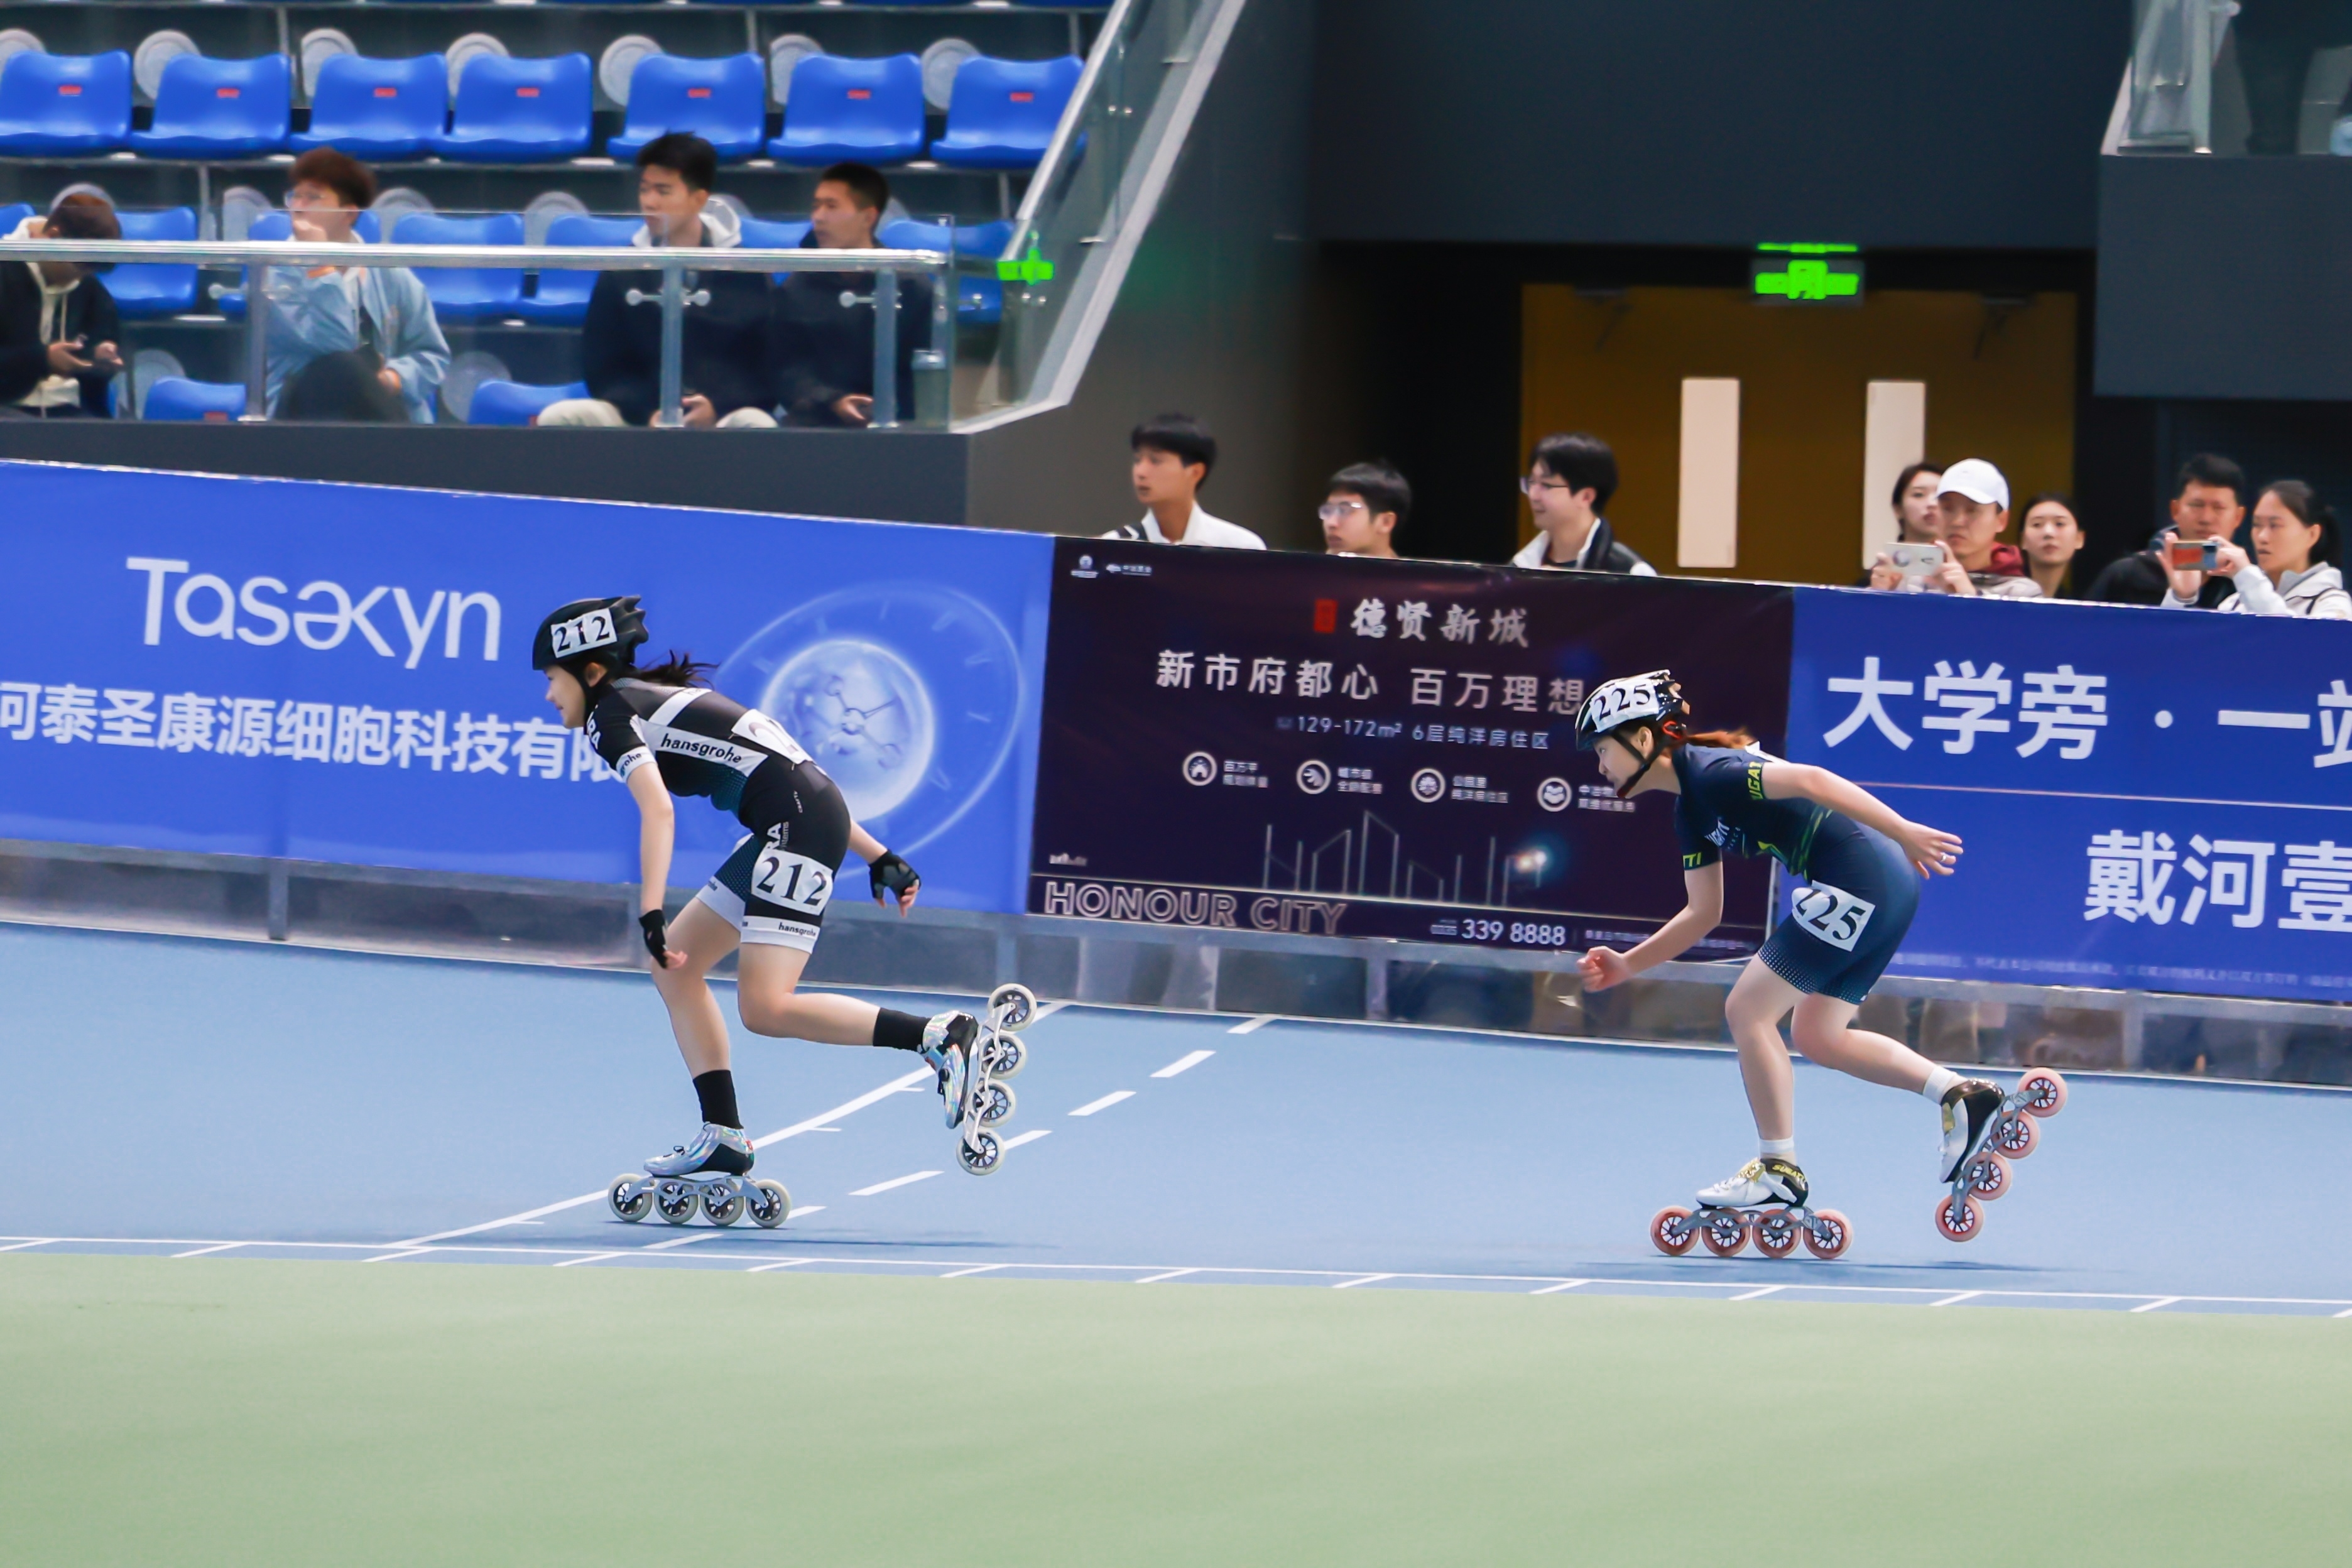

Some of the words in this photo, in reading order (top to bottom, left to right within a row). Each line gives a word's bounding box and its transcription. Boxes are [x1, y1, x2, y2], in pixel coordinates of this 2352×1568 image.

[554, 616, 610, 652] 212
[1351, 598, 1527, 647] 德贤新城
[1157, 650, 1378, 700] 新市府都心
[1410, 668, 1584, 715] 百万理想
[1594, 684, 1650, 722] 225
[660, 732, 742, 763] hansgrohe
[756, 857, 827, 906] 212
[2084, 829, 2352, 933] 戴河壹
[1044, 881, 1237, 927] HONOUR
[1250, 897, 1348, 934] CITY
[1461, 918, 1504, 940] 339
[1510, 922, 1566, 945] 8888
[1795, 888, 1866, 940] 225
